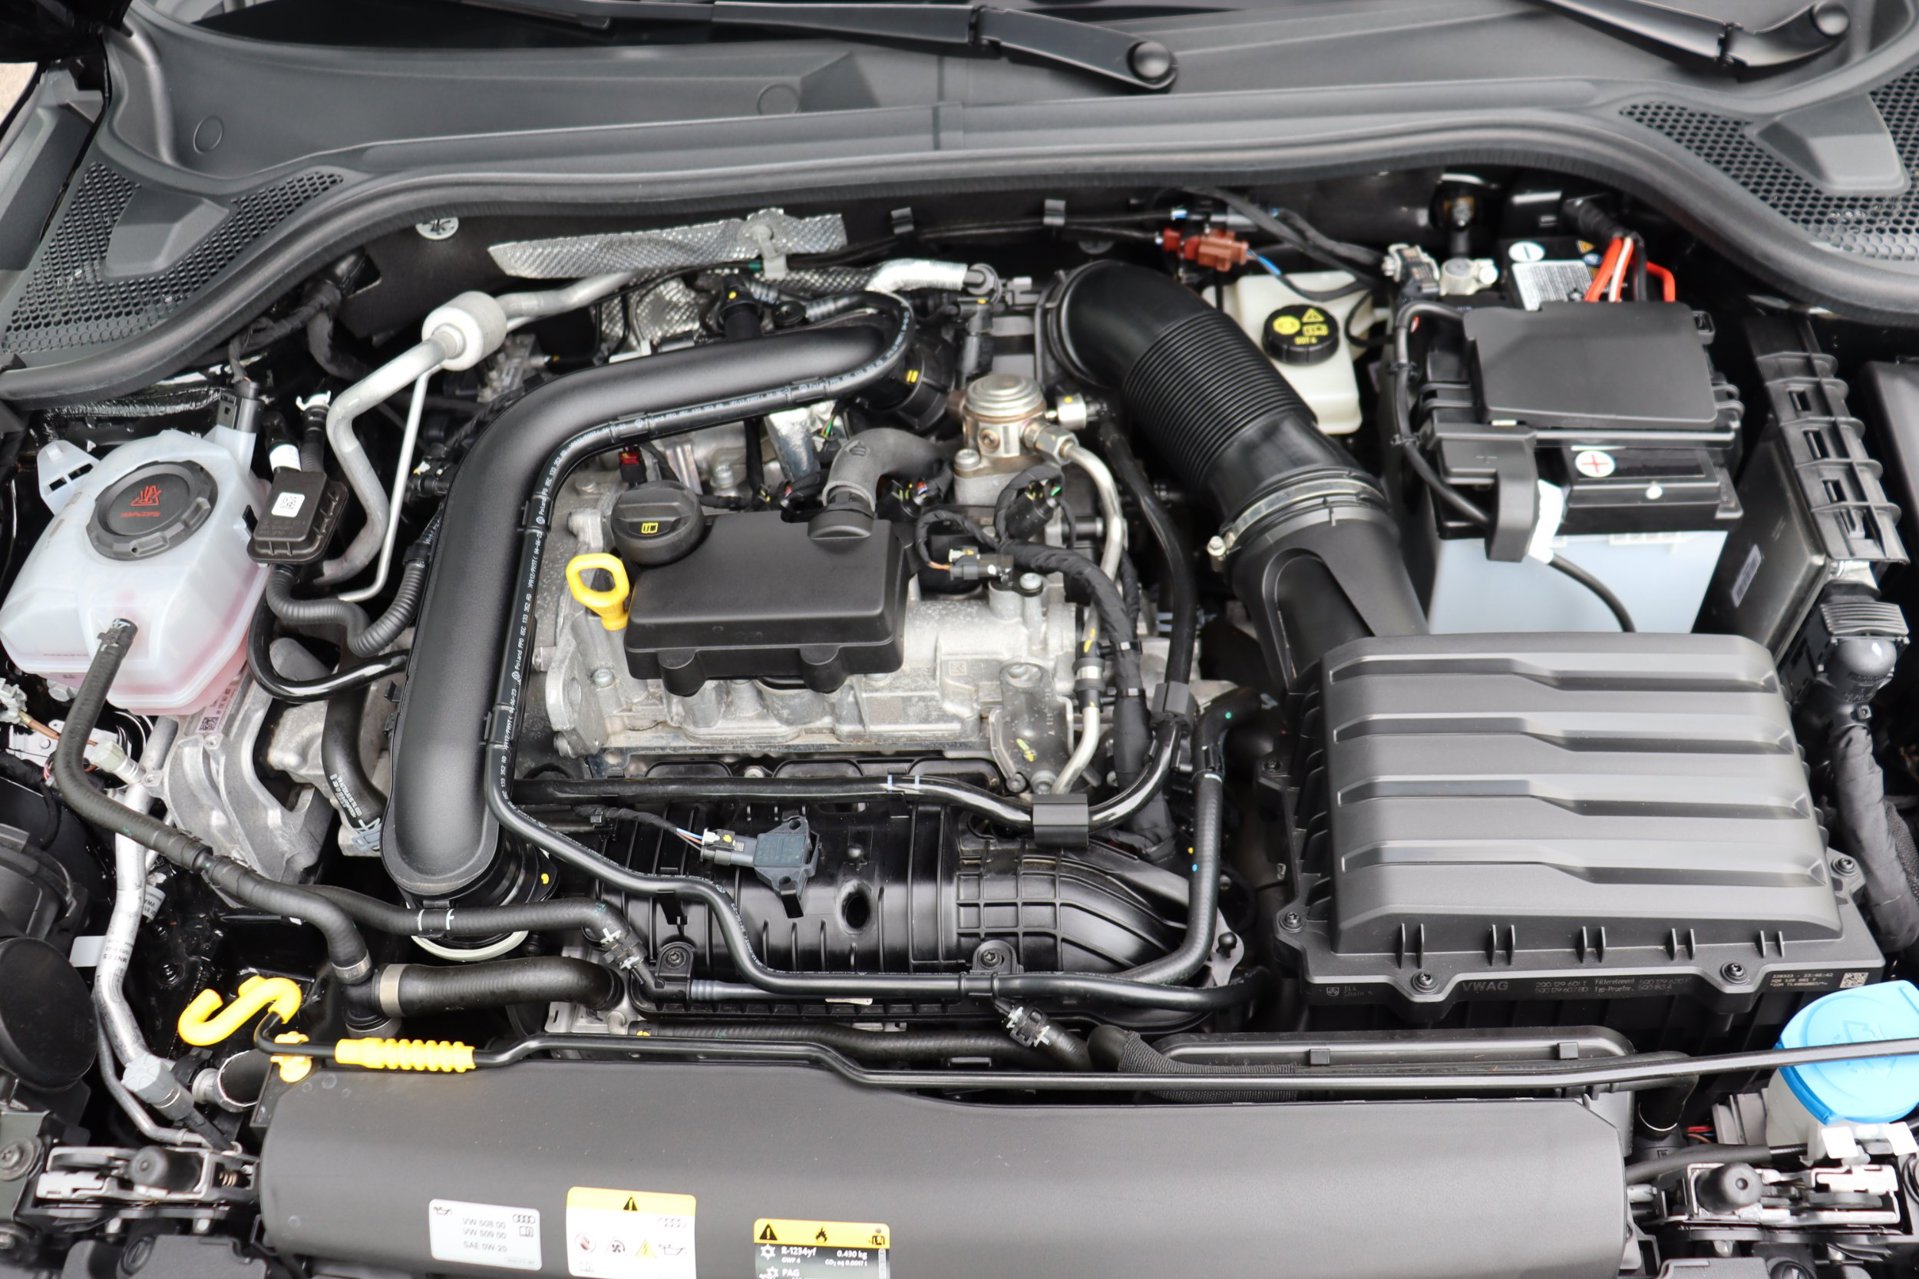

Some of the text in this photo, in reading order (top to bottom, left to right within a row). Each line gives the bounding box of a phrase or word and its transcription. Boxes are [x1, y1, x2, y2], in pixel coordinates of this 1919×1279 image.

[1462, 981, 1509, 993] VWAG
[781, 1247, 817, 1258] R-1234yf
[859, 1250, 868, 1259] kg
[781, 1268, 800, 1278] PAG
